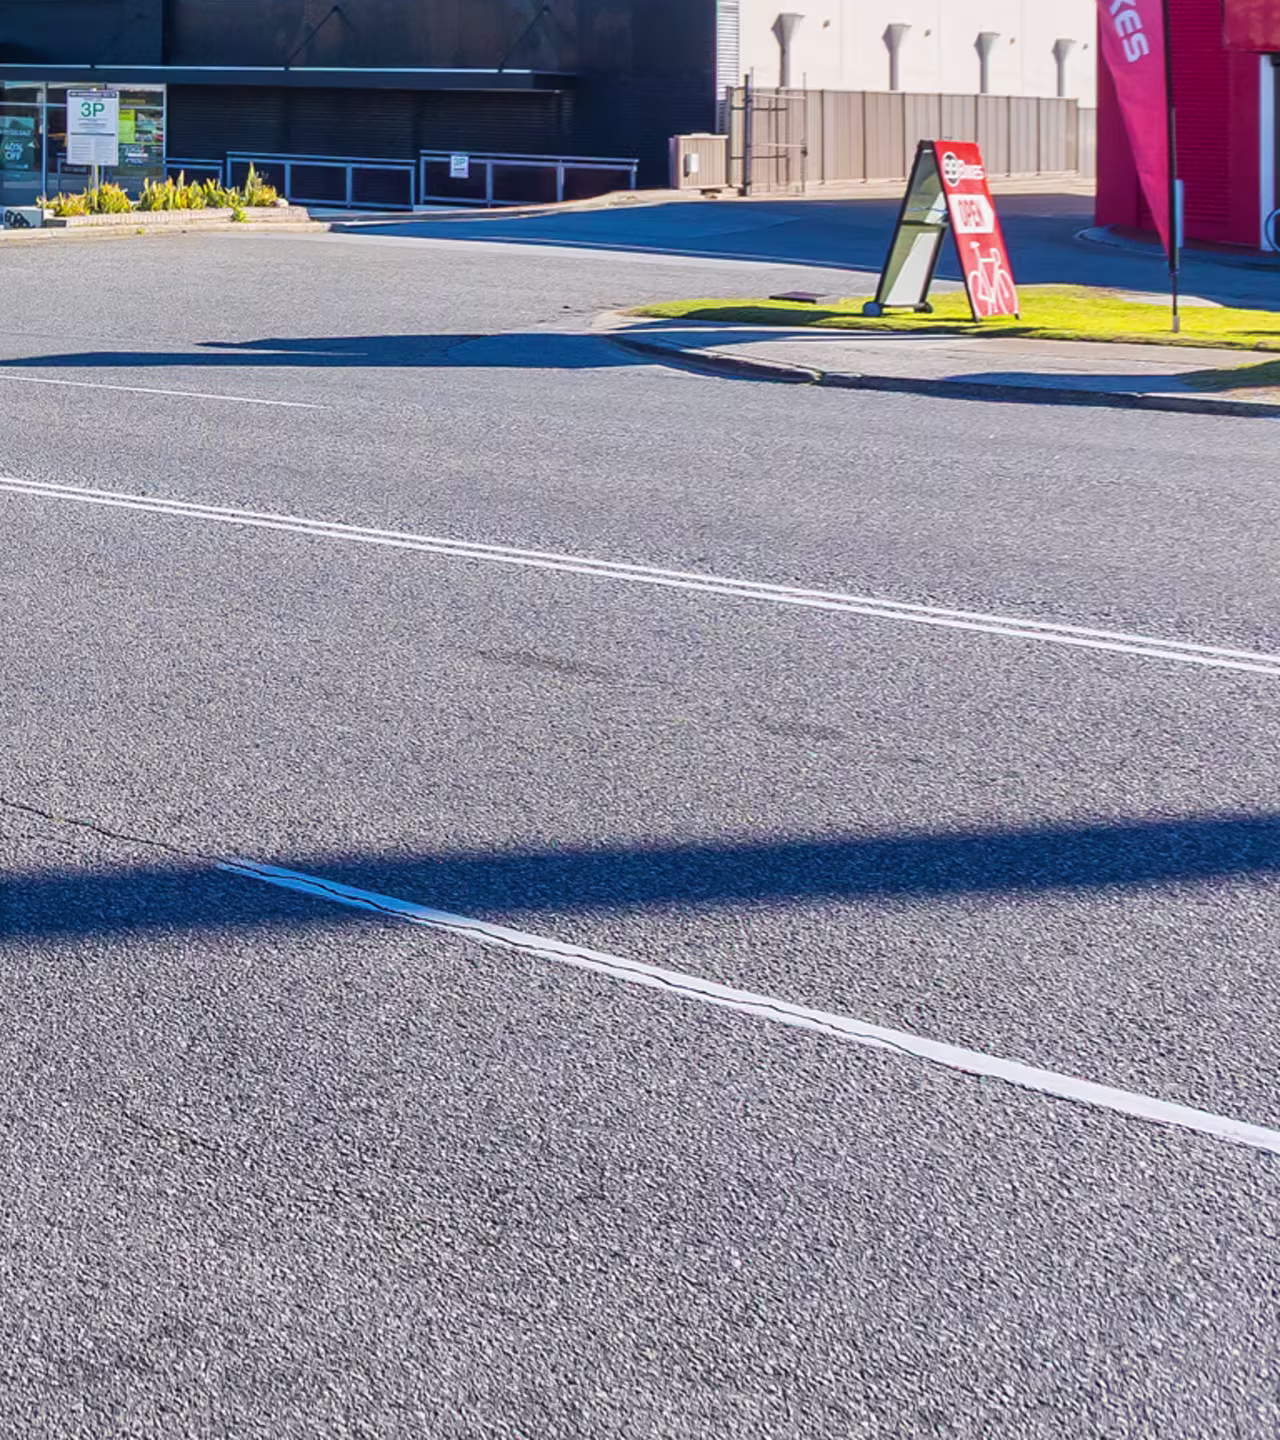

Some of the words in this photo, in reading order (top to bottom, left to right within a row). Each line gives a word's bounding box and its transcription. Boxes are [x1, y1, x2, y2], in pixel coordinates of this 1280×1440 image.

[81, 102, 105, 117] 3P
[5, 151, 22, 160] OFF
[958, 199, 986, 227] OPEN
